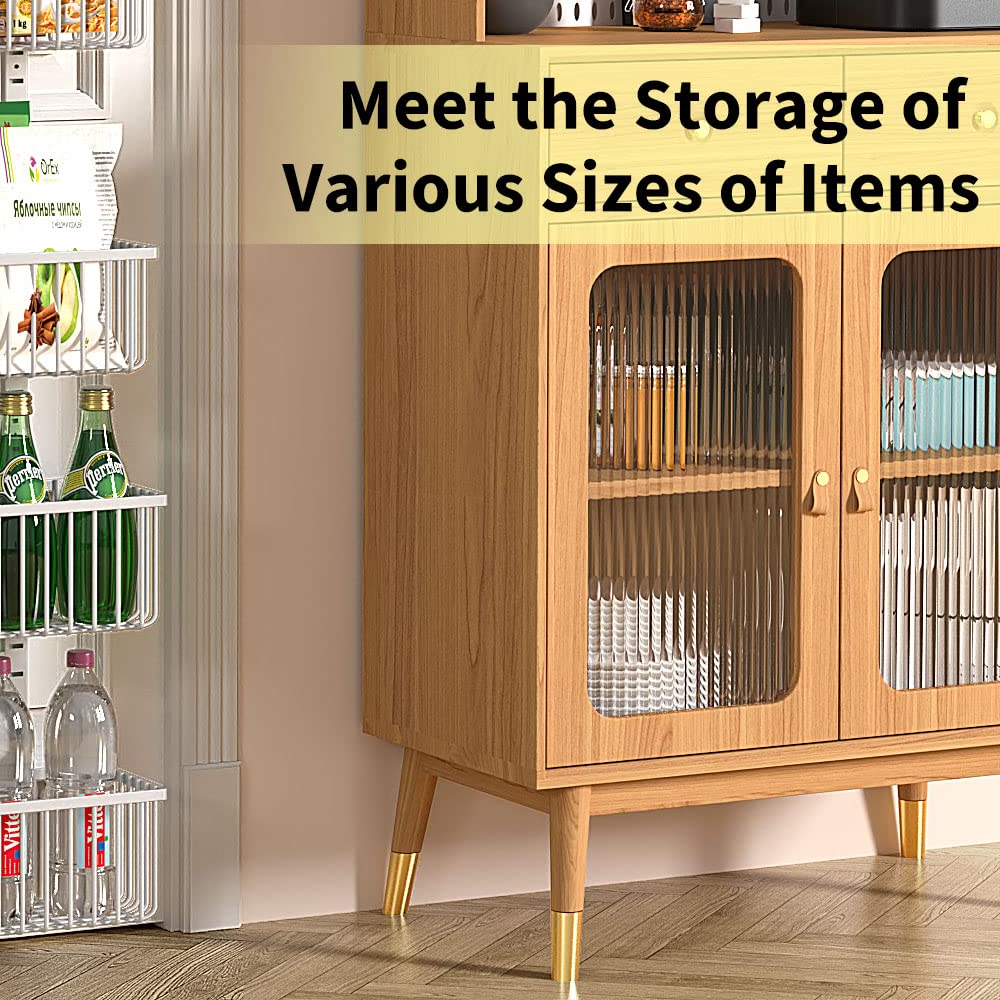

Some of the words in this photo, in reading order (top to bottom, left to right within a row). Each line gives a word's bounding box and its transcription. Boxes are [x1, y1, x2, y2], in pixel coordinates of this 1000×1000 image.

[18, 19, 27, 29] kg
[41, 159, 59, 175] OrEx
[14, 199, 55, 217] Яблочные
[57, 202, 82, 216] чипсы
[4, 460, 43, 493] Perrier
[86, 454, 124, 488] Perrier
[3, 812, 20, 852] Vitte
